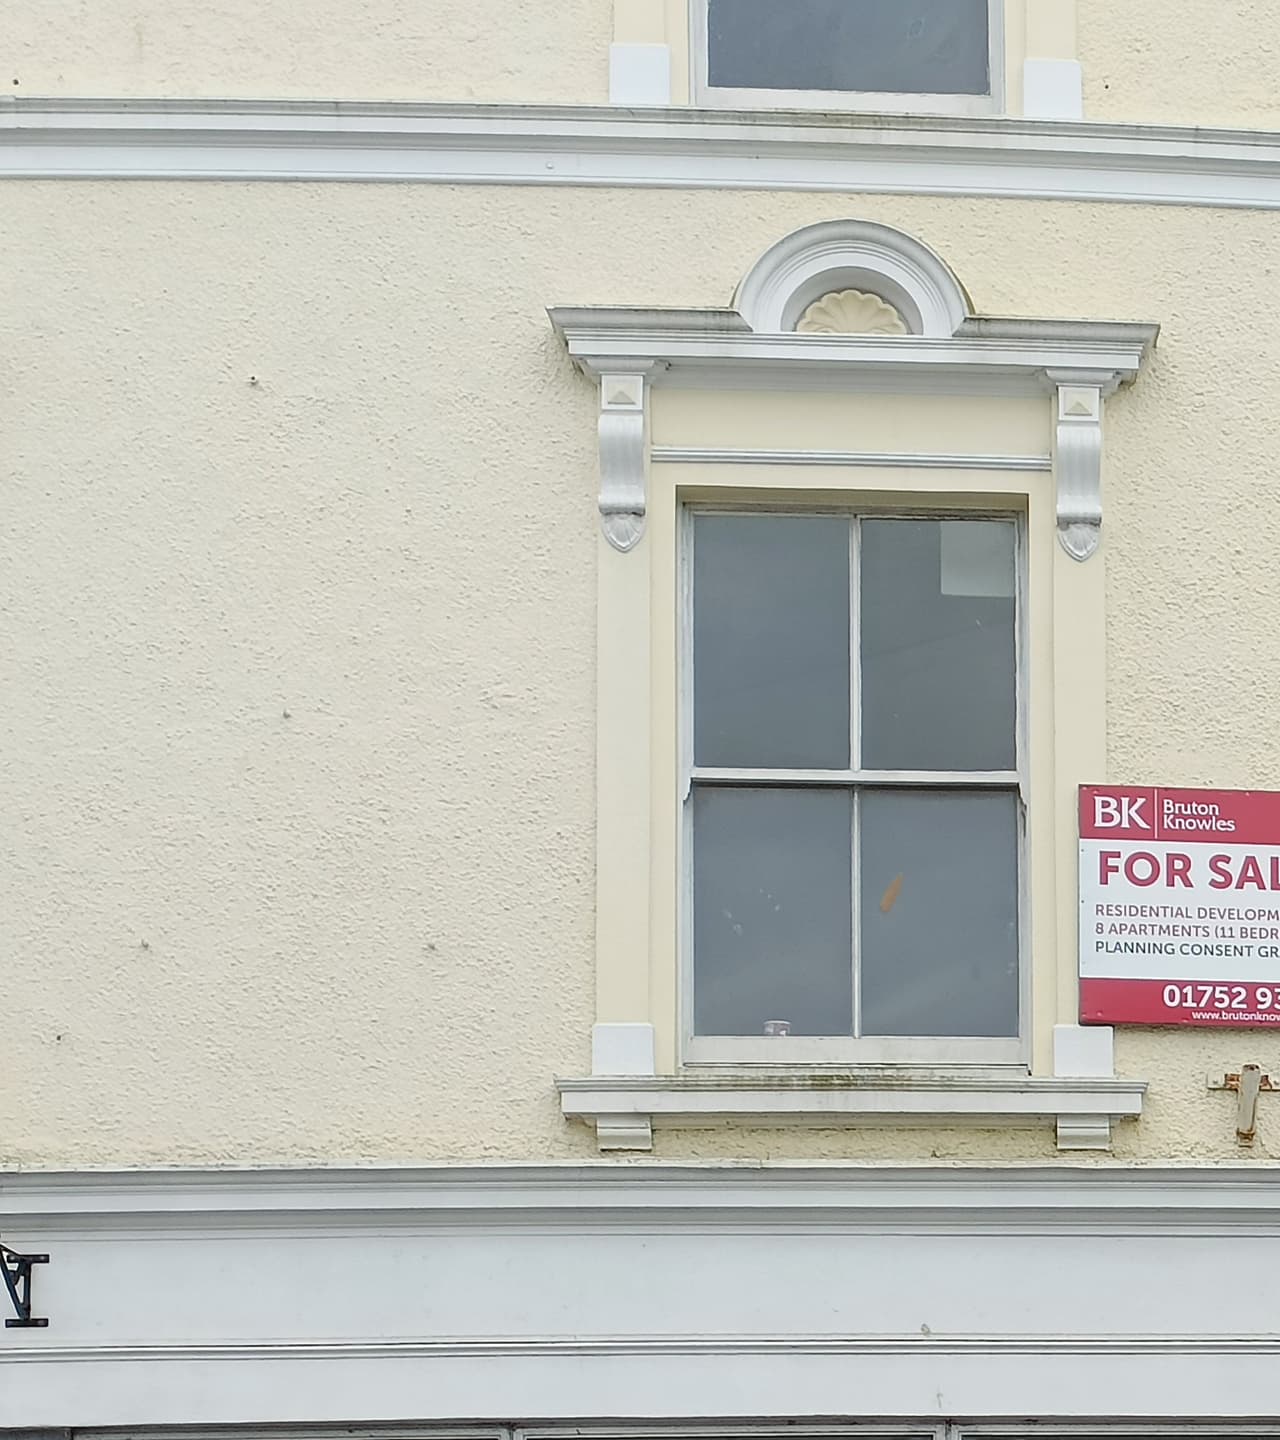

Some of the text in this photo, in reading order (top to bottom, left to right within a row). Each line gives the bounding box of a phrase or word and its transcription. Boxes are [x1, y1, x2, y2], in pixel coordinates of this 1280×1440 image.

[1093, 796, 1151, 829] BK
[1163, 799, 1219, 816] Bruton
[1163, 814, 1236, 831] Knowles
[1099, 850, 1194, 888] FOR
[1095, 904, 1193, 919] RESIDENTIAL
[1095, 923, 1104, 935] 8
[1108, 923, 1210, 938] APARTMENTS
[1095, 941, 1175, 955] PLANNING
[1180, 943, 1254, 957] CONSENT
[1163, 985, 1248, 1009] 01752
